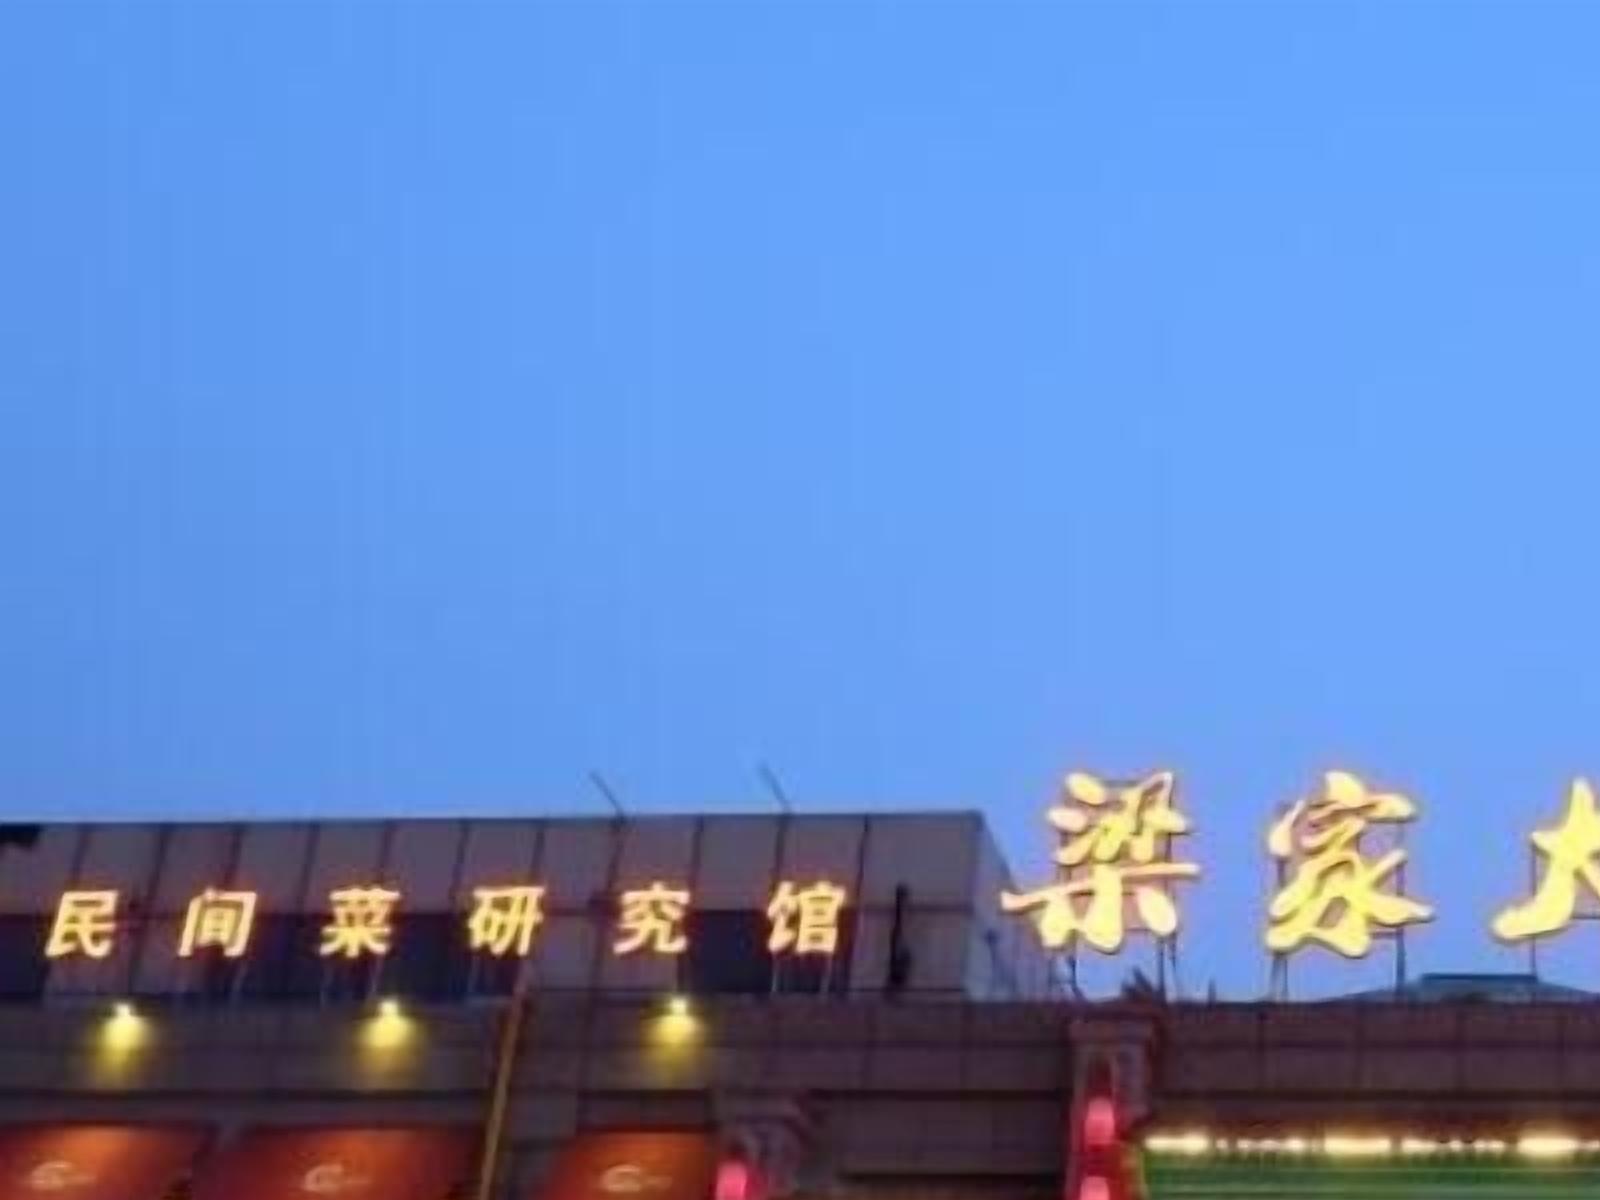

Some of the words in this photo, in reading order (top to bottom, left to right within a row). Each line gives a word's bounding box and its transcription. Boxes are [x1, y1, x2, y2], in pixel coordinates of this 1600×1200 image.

[44, 882, 846, 958] 民间菜研究馆
